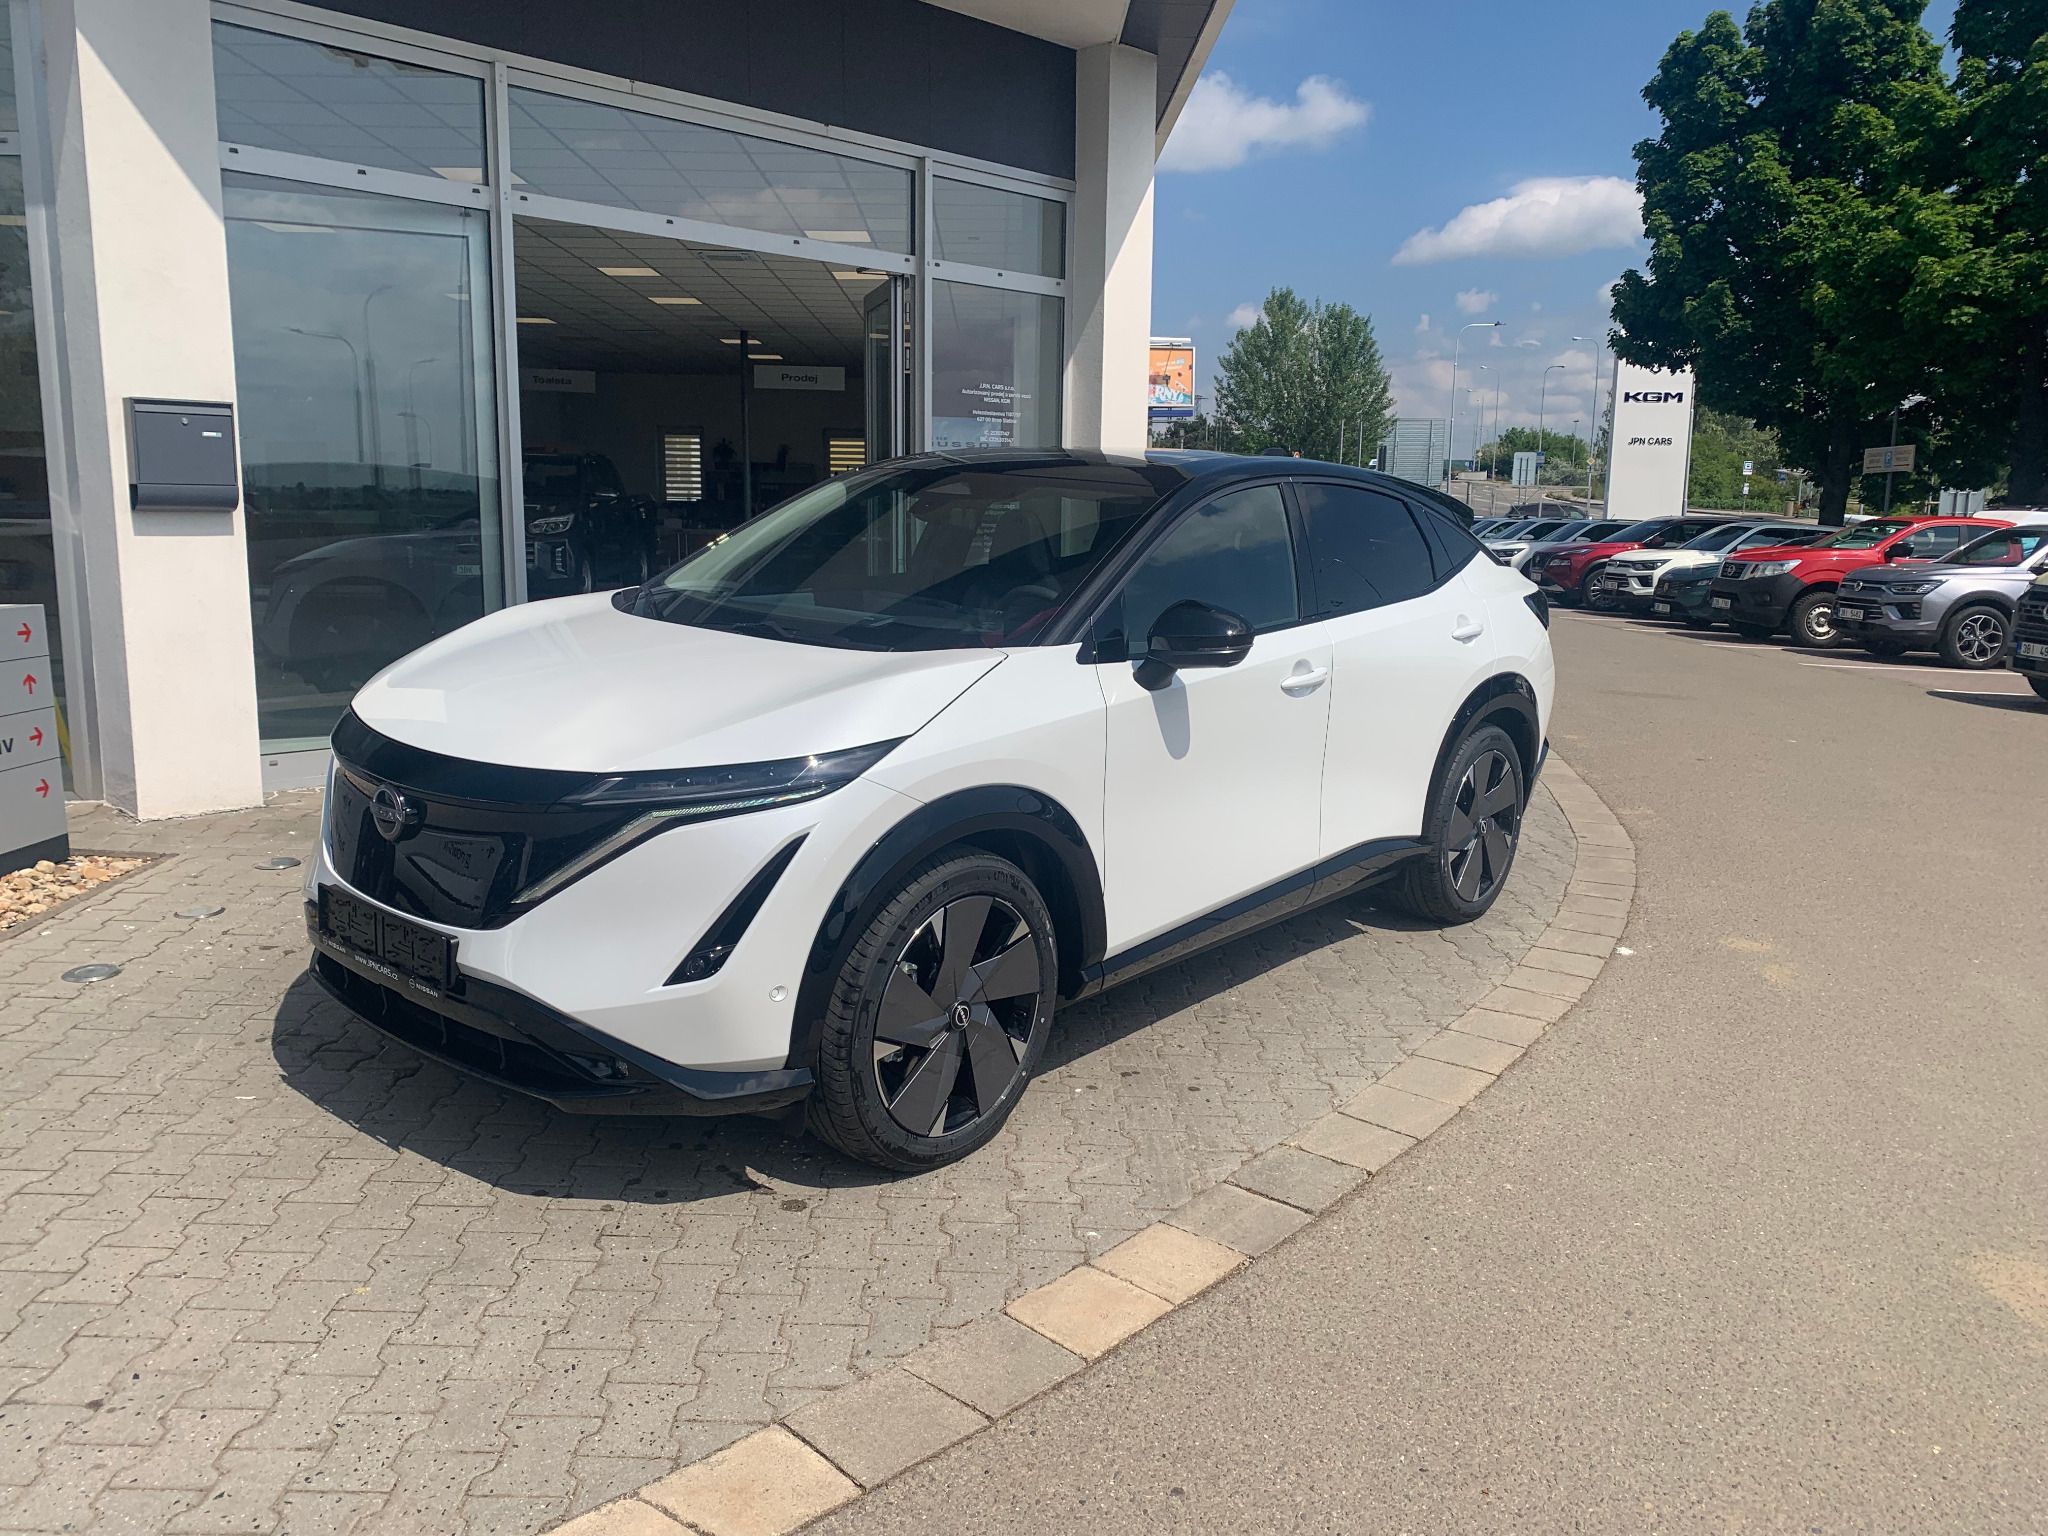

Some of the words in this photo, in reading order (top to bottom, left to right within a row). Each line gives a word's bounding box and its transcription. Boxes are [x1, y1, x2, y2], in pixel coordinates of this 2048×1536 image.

[781, 373, 818, 384] Prodej
[1624, 392, 1684, 403] KGM
[1628, 437, 1646, 446] JPN
[1648, 437, 1673, 446] CARS
[415, 983, 439, 998] NISSAN
